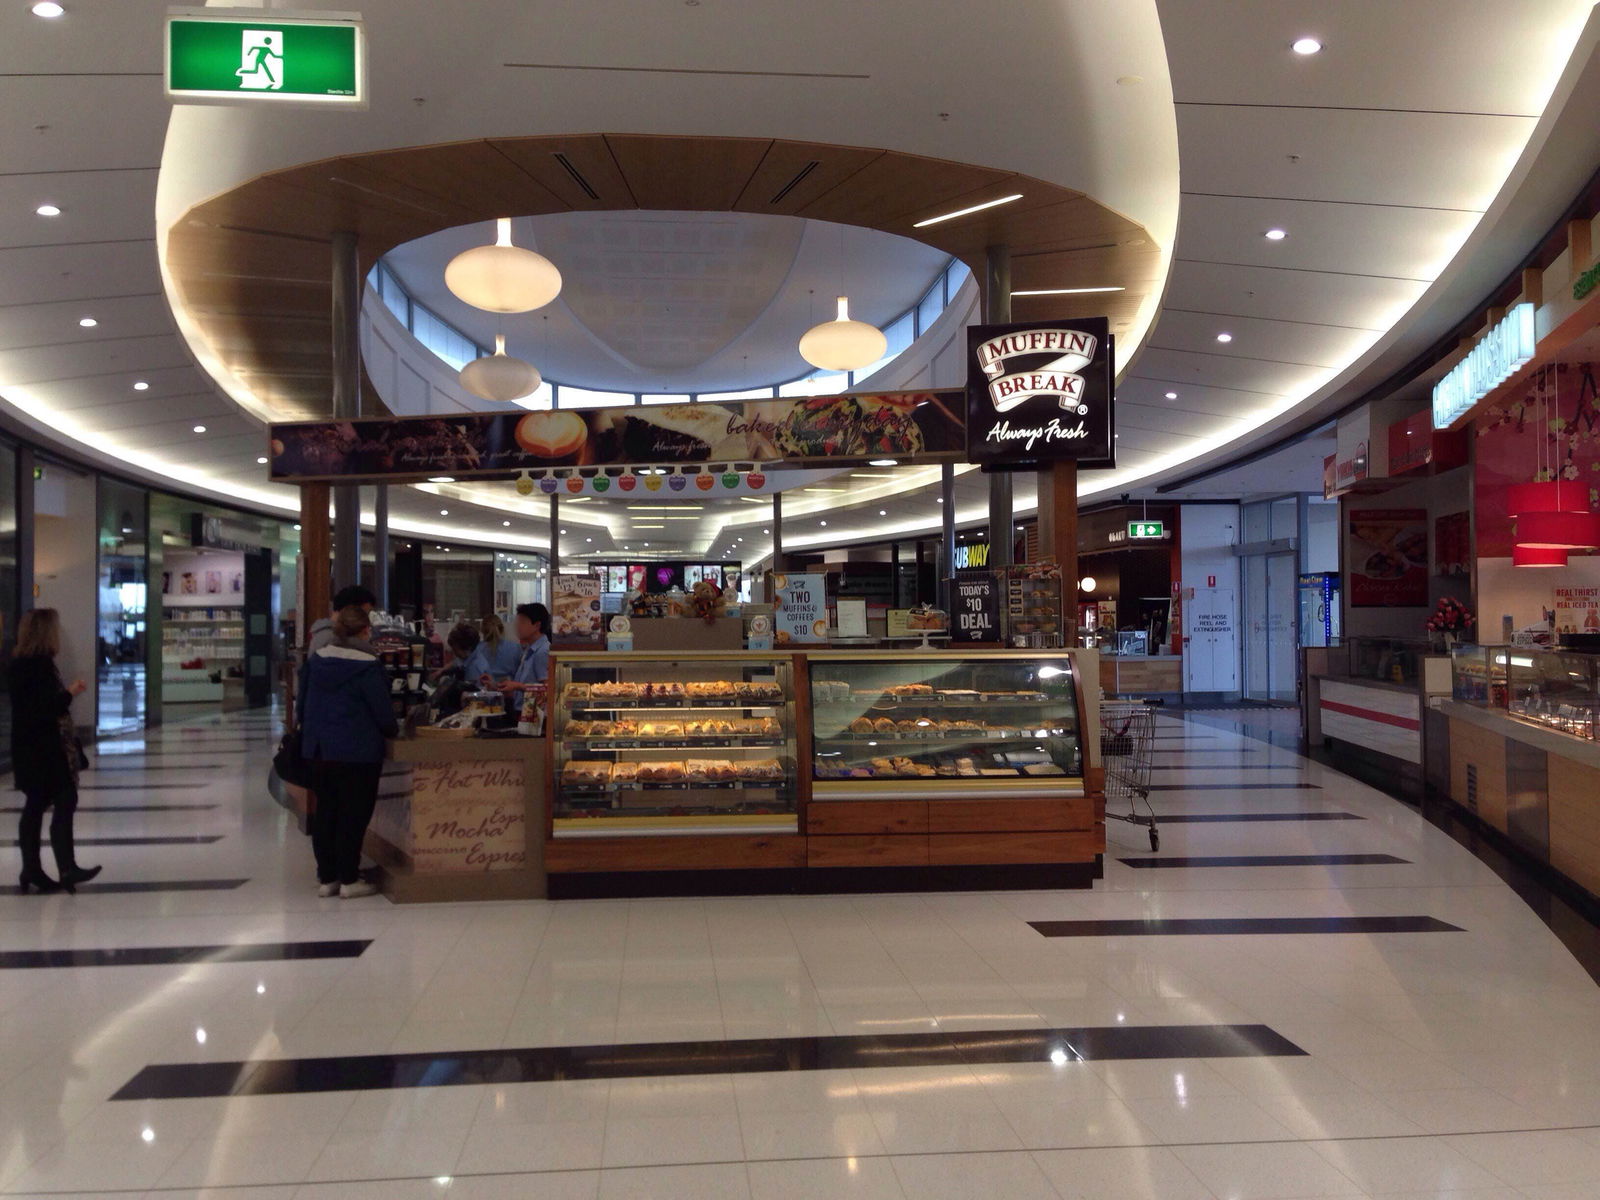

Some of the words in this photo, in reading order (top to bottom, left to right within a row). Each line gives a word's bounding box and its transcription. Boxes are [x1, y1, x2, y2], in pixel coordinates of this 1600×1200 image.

[987, 332, 1089, 359] MUFFIN
[997, 375, 1079, 397] BREAK
[726, 409, 795, 435] baked
[986, 420, 1042, 451] Always
[1043, 418, 1088, 443] Fresh
[652, 440, 686, 457] Always
[790, 591, 811, 603] TWO
[959, 585, 990, 596] TODAY'S
[1556, 589, 1573, 597] REAL
[1575, 588, 1598, 597] THIRST
[783, 604, 811, 612] MUFFINS
[966, 598, 982, 611] $10
[787, 613, 814, 621] COFFEES
[960, 613, 992, 629] DEAL
[794, 625, 808, 635] $10
[432, 769, 483, 793] Flat
[426, 818, 504, 839] Mocha
